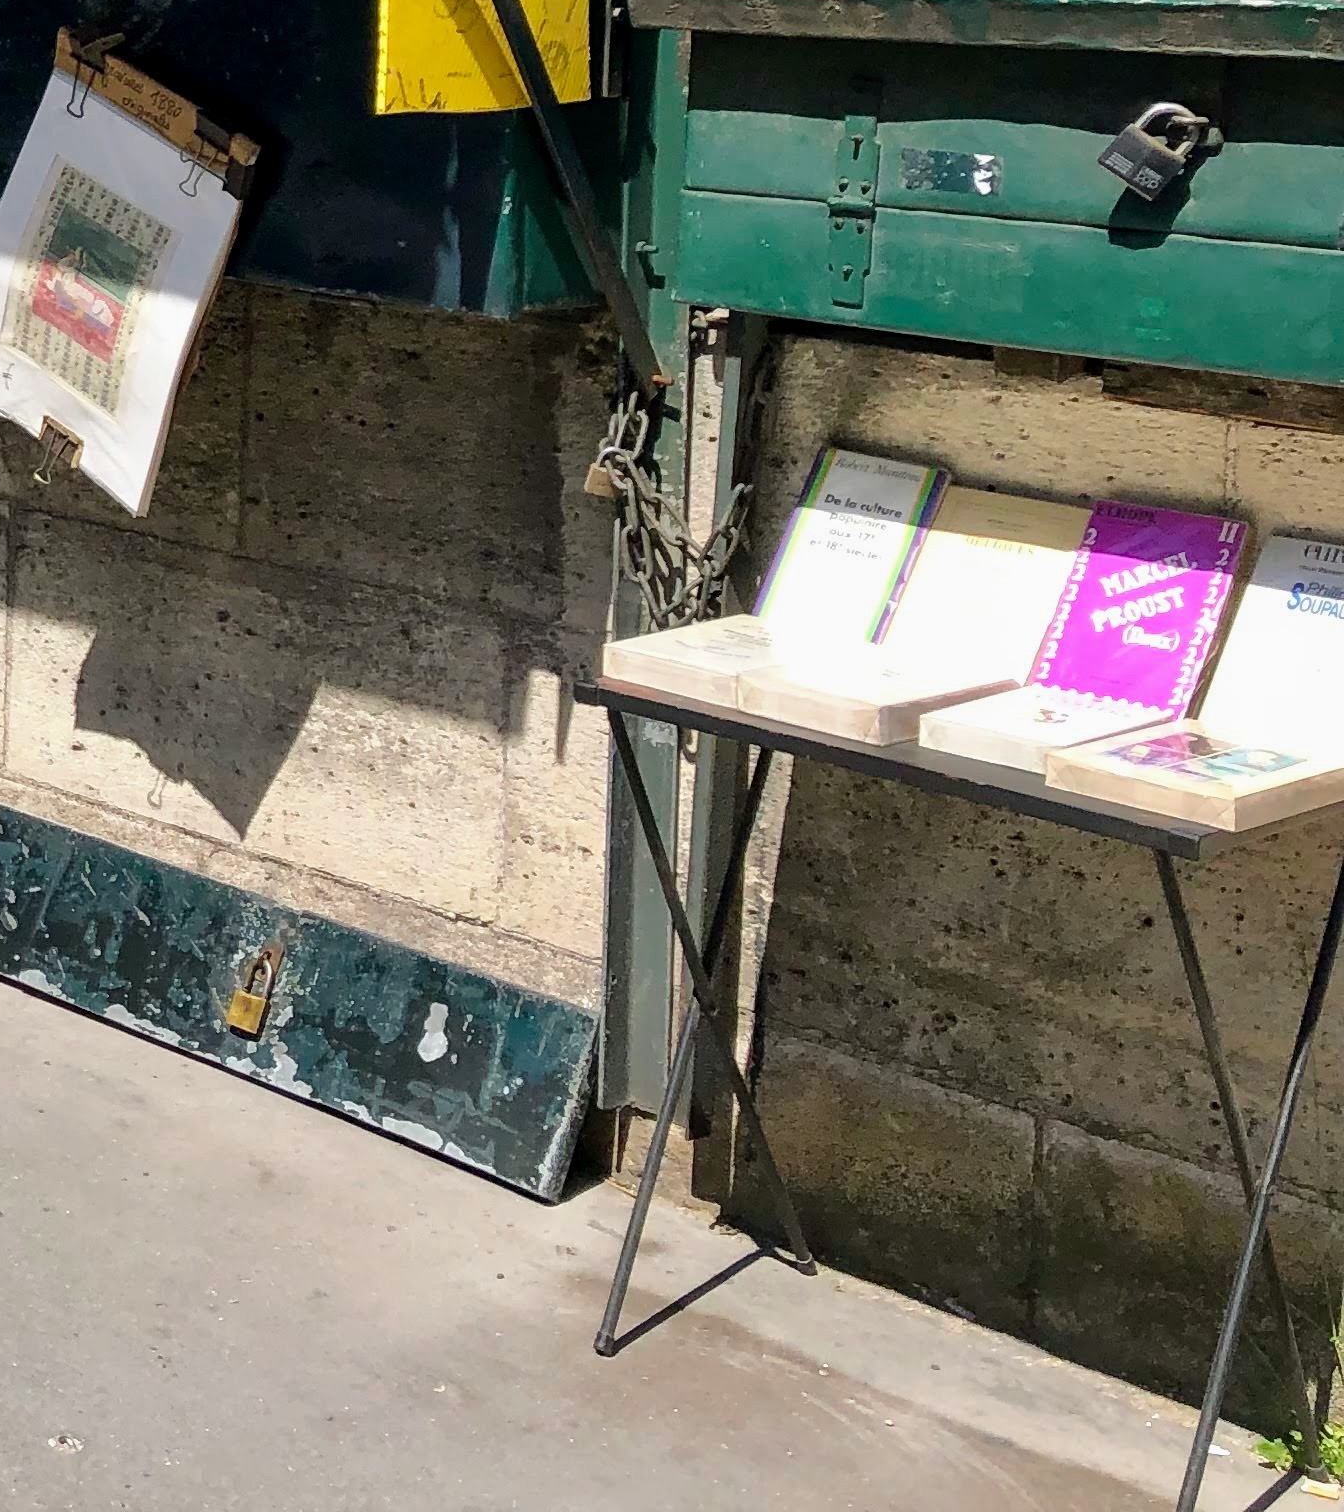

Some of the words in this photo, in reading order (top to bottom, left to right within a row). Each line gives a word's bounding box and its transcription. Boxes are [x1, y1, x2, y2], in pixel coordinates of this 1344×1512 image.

[150, 90, 182, 119] 1880
[824, 494, 842, 507] De
[844, 497, 858, 509] la
[859, 501, 904, 519] culture
[1099, 552, 1195, 598] MARCEL
[1090, 587, 1184, 633] PROUST
